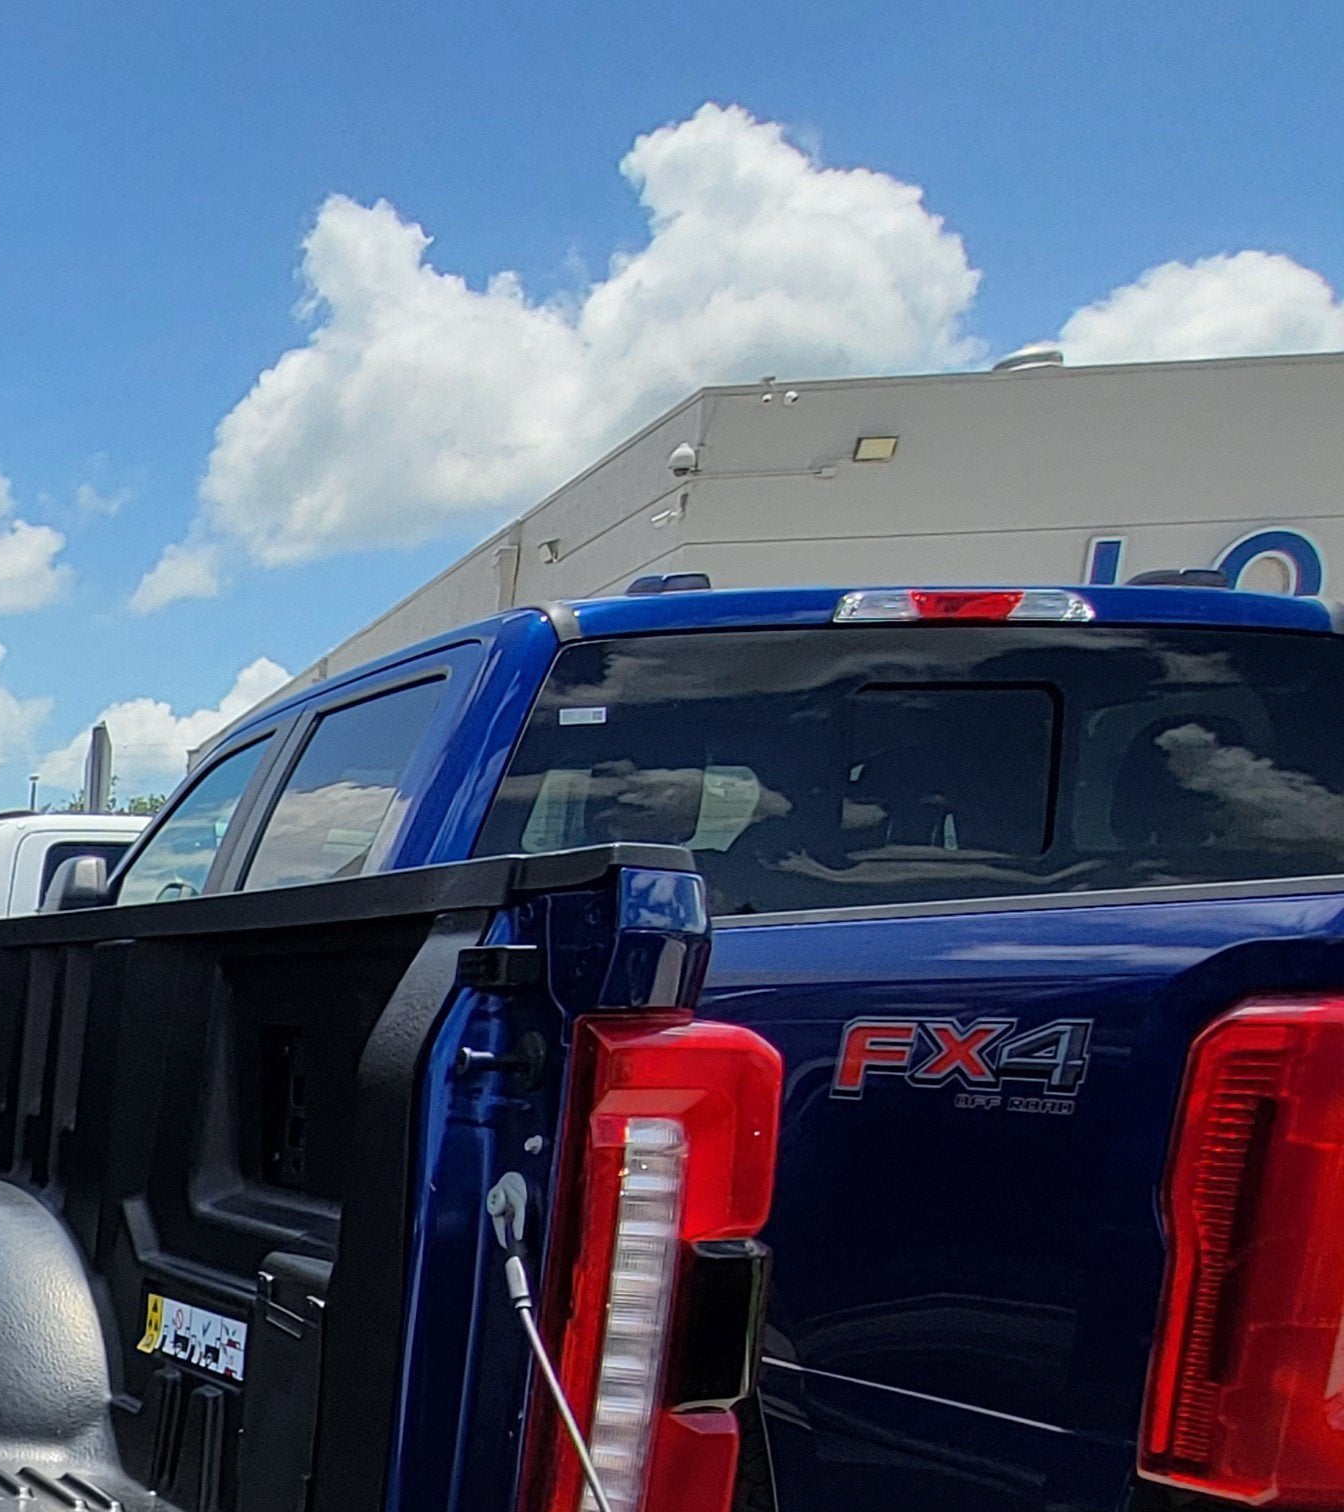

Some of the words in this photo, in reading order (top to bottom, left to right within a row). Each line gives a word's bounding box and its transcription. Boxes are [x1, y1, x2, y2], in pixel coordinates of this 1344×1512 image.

[828, 1015, 1094, 1100] FX4
[954, 1093, 1003, 1110] OFF
[1007, 1096, 1076, 1116] ROAD
